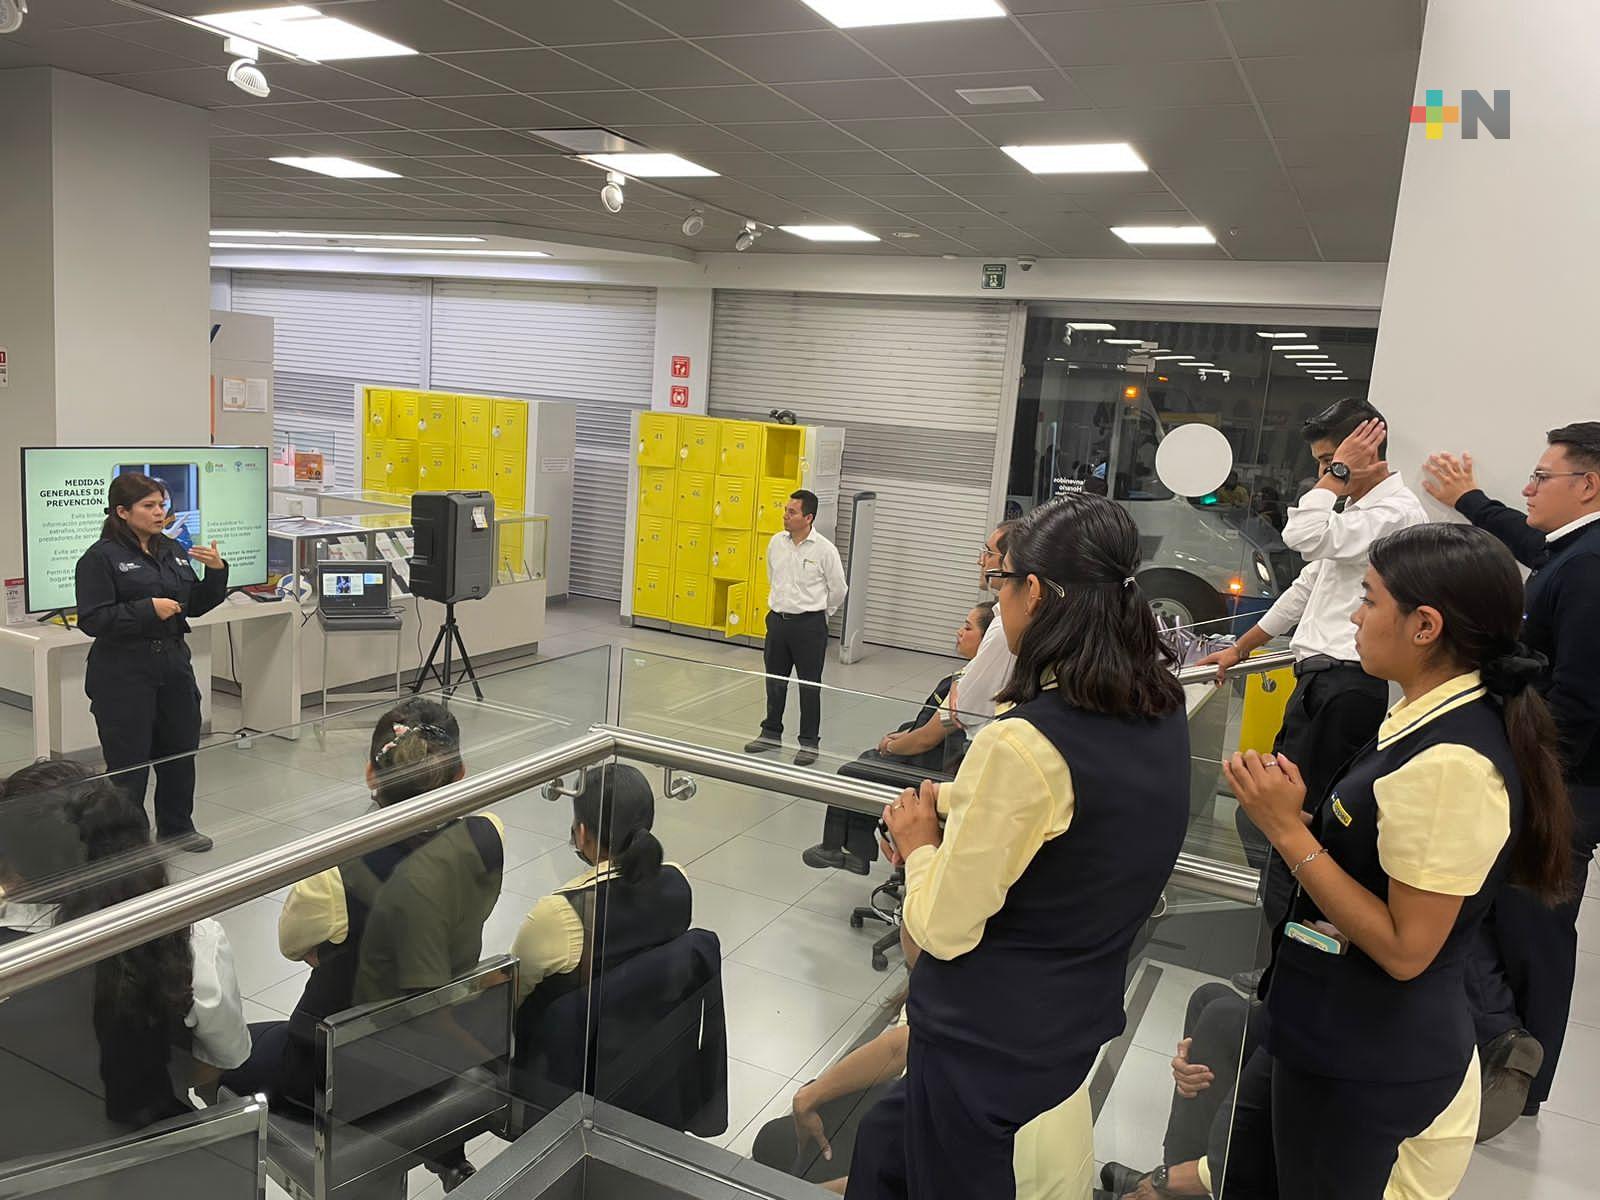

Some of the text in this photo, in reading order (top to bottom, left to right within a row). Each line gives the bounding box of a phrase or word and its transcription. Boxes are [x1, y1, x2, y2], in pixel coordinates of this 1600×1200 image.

[65, 478, 105, 487] MEDIDAS
[39, 488, 105, 498] GENERALES DE
[46, 497, 105, 508] PREVENCIÓN.
[729, 495, 740, 503] 50
